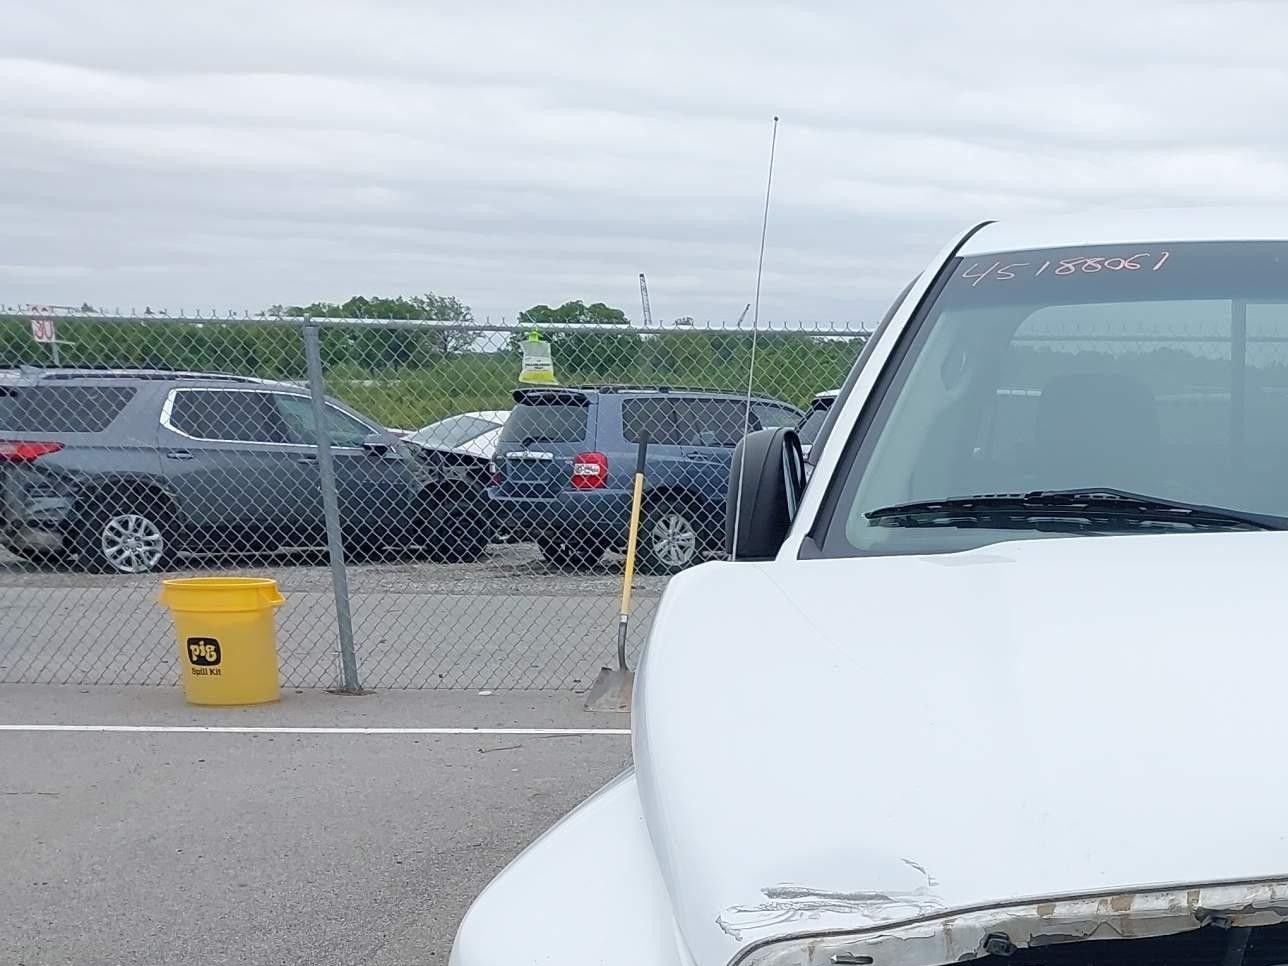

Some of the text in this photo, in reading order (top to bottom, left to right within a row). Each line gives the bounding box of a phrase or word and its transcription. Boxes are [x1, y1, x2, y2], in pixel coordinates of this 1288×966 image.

[962, 251, 1169, 287] 45188061
[190, 640, 217, 662] pig
[192, 667, 222, 677] Spill Kit
